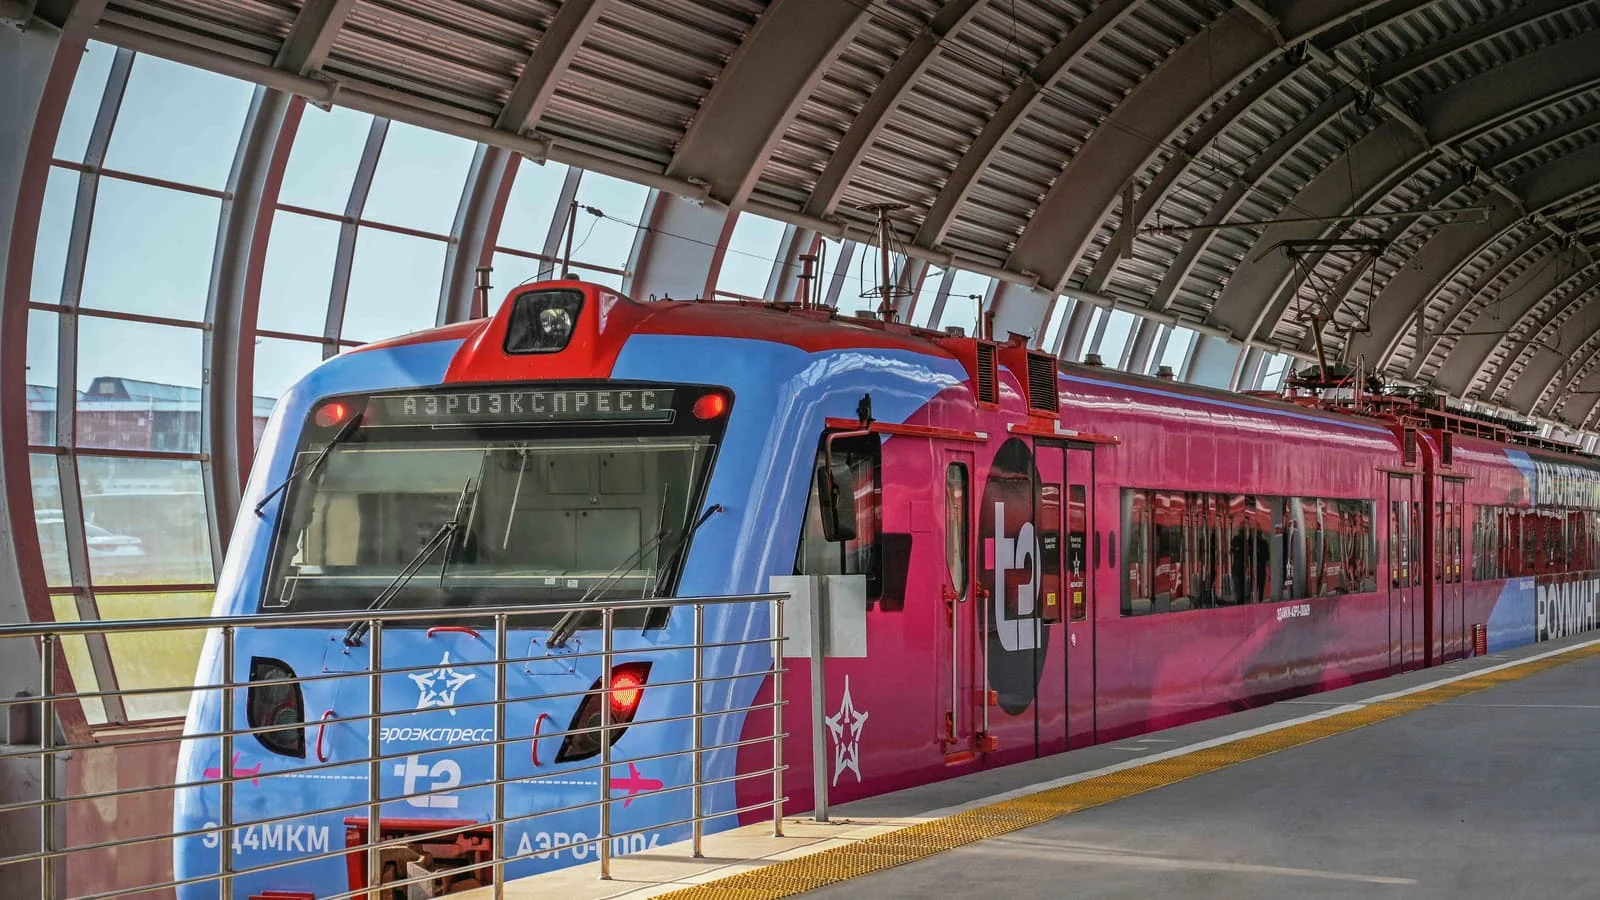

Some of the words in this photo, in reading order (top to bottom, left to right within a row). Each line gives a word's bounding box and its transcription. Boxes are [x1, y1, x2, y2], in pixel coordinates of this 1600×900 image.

[403, 391, 655, 415] АЭРОЭКСПРЕСС
[1537, 579, 1600, 642] РОУМИНГ
[369, 727, 494, 745] эроэкспресс
[394, 753, 462, 809] t2
